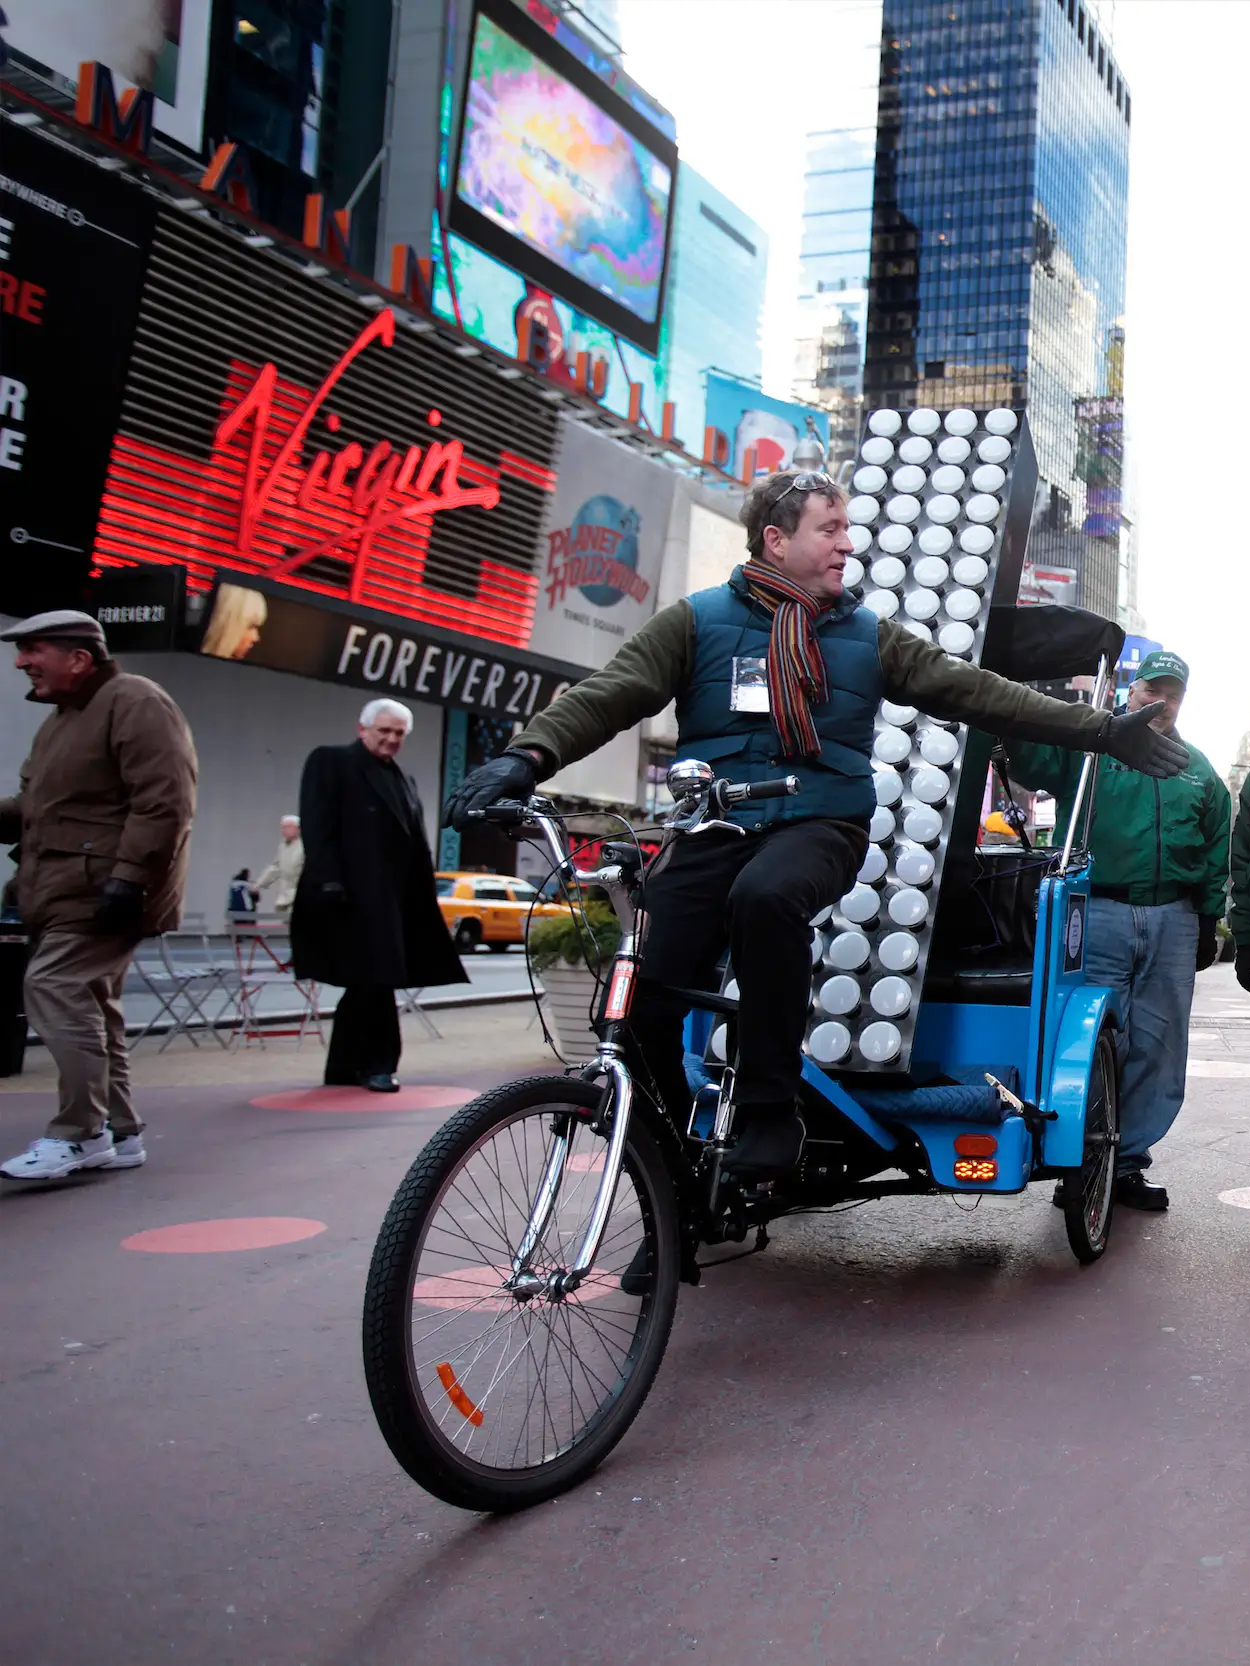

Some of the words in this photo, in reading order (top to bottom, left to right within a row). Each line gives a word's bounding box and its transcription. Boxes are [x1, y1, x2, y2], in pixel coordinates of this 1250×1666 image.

[216, 307, 500, 601] Virgin
[545, 554, 650, 610] HOLLYWOOD
[547, 523, 625, 576] PLANET
[337, 624, 506, 709] FOREVER
[505, 669, 542, 717] 21
